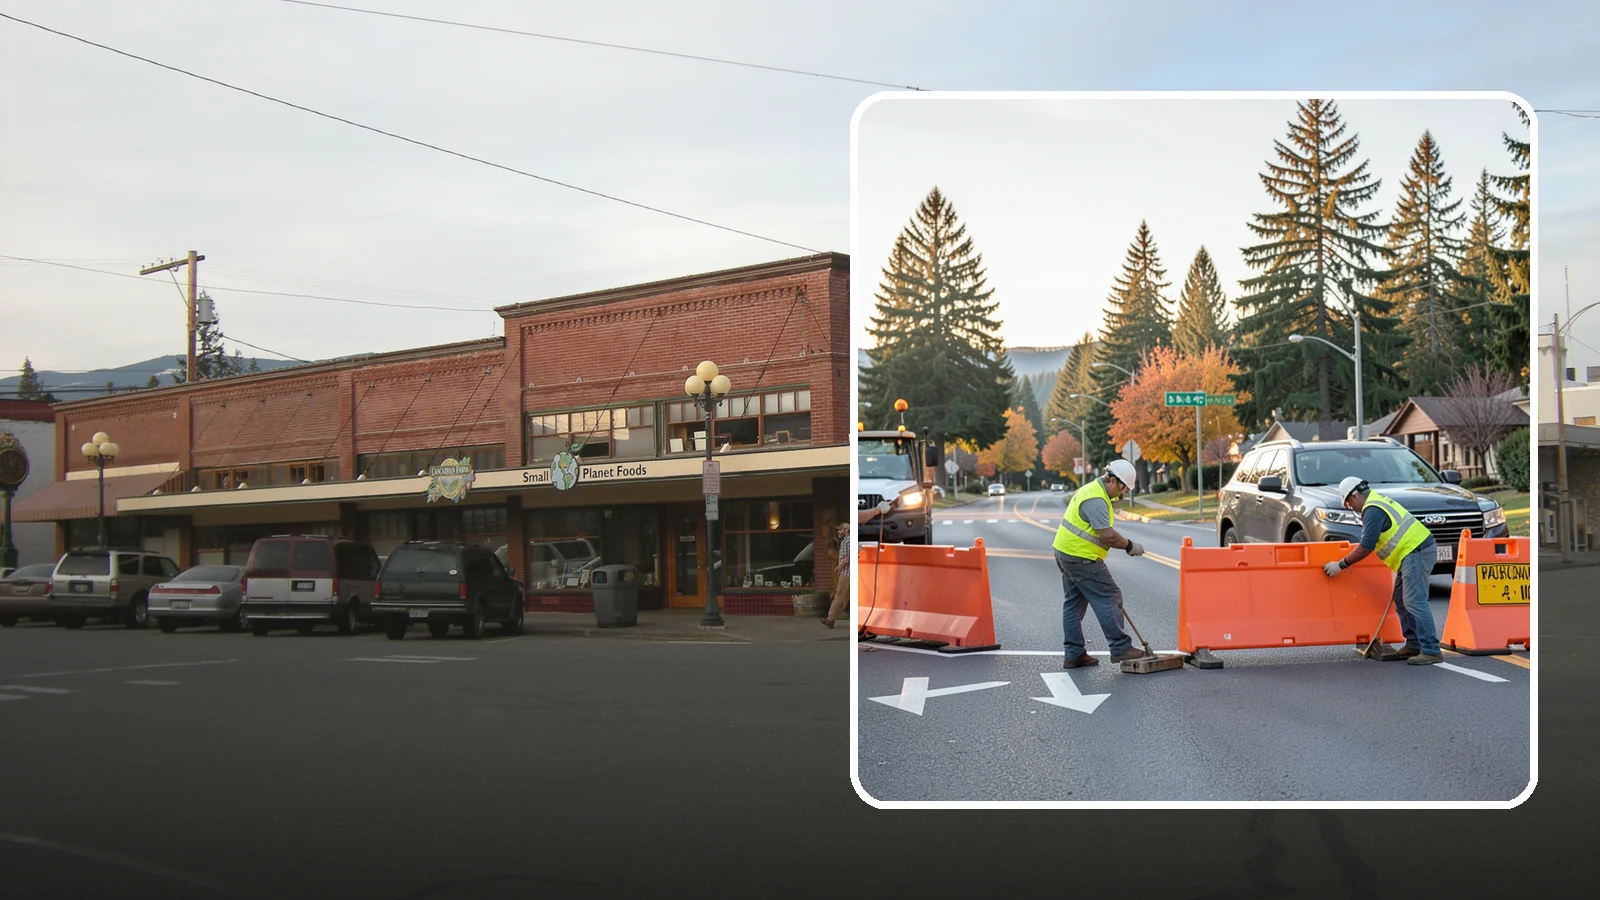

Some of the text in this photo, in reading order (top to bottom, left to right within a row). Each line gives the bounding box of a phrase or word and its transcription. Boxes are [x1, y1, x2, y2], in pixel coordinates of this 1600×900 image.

[523, 464, 647, 483] Small Planet Foods
